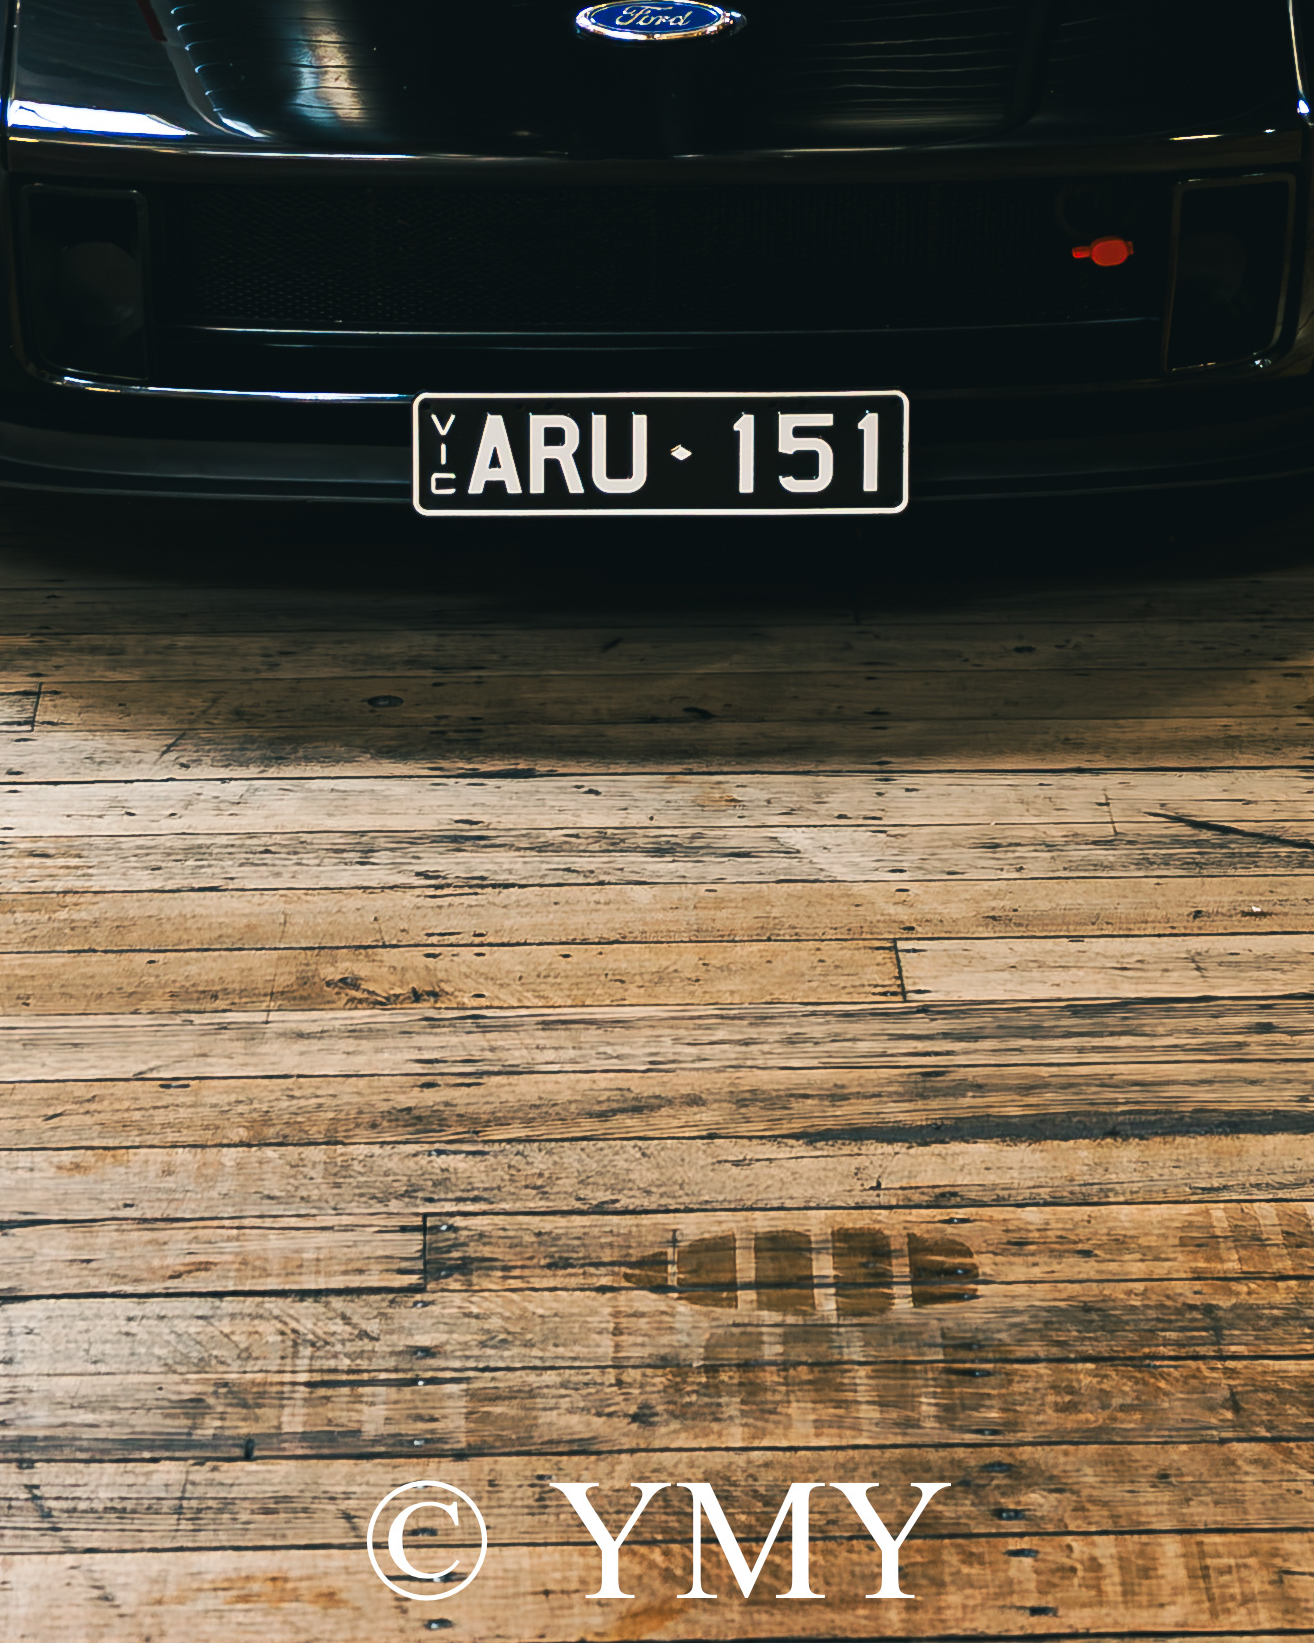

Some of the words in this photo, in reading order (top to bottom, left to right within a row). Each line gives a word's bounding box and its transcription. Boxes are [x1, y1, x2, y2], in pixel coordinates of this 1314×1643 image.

[615, 4, 694, 27] Ford
[430, 412, 457, 496] VIC
[467, 411, 649, 496] ARU
[731, 409, 880, 495] 151
